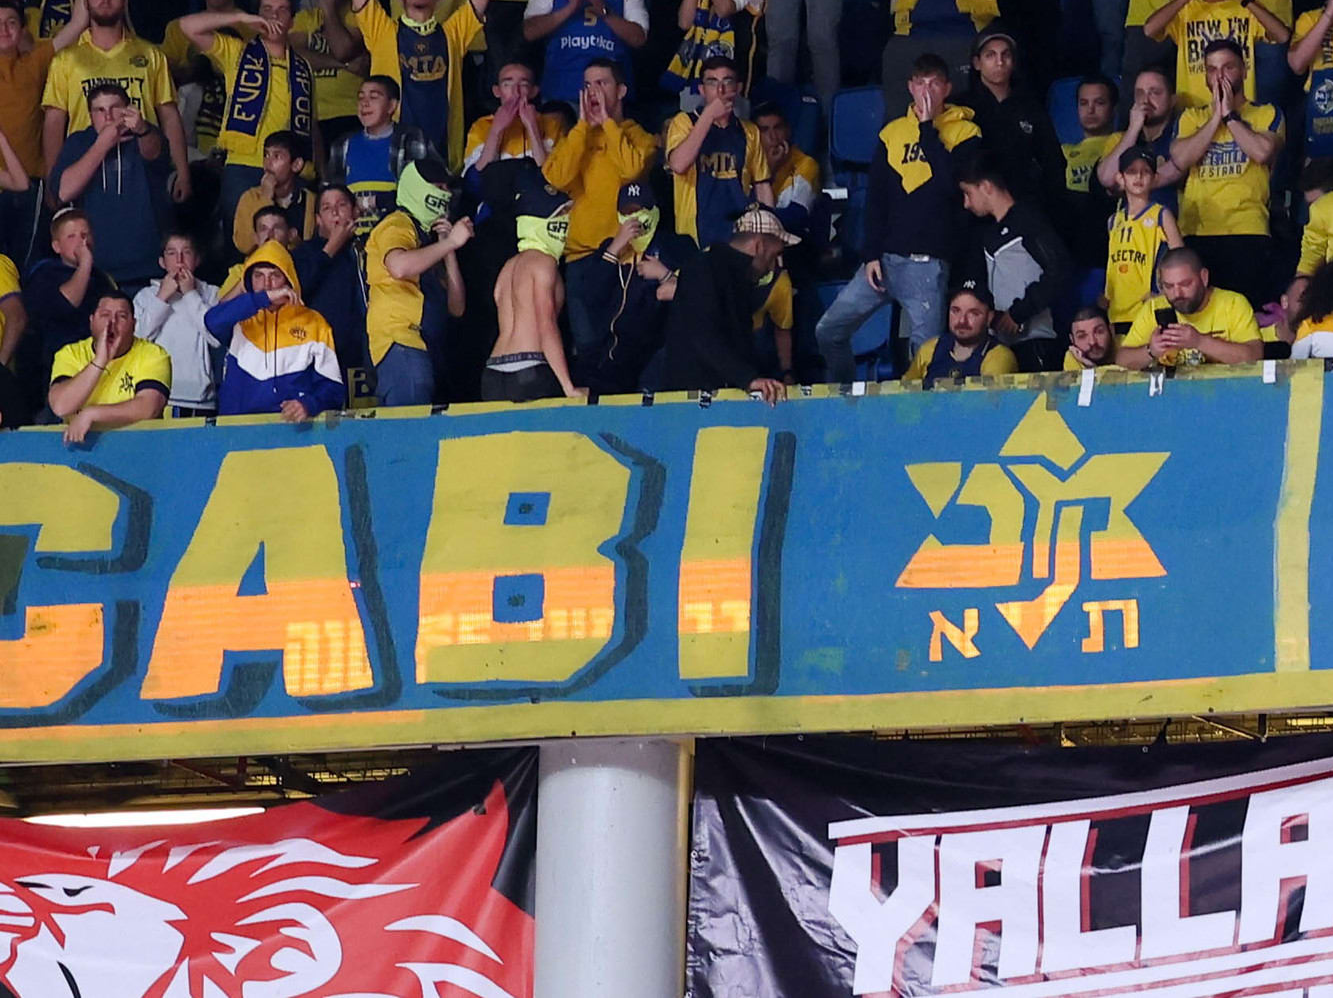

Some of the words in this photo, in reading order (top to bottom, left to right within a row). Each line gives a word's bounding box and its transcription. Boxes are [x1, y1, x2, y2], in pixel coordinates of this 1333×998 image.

[560, 33, 615, 52] playtika
[400, 54, 447, 83] MTA
[233, 54, 265, 124] FUCK
[699, 152, 738, 180] MTA
[1119, 227, 1132, 243] 11
